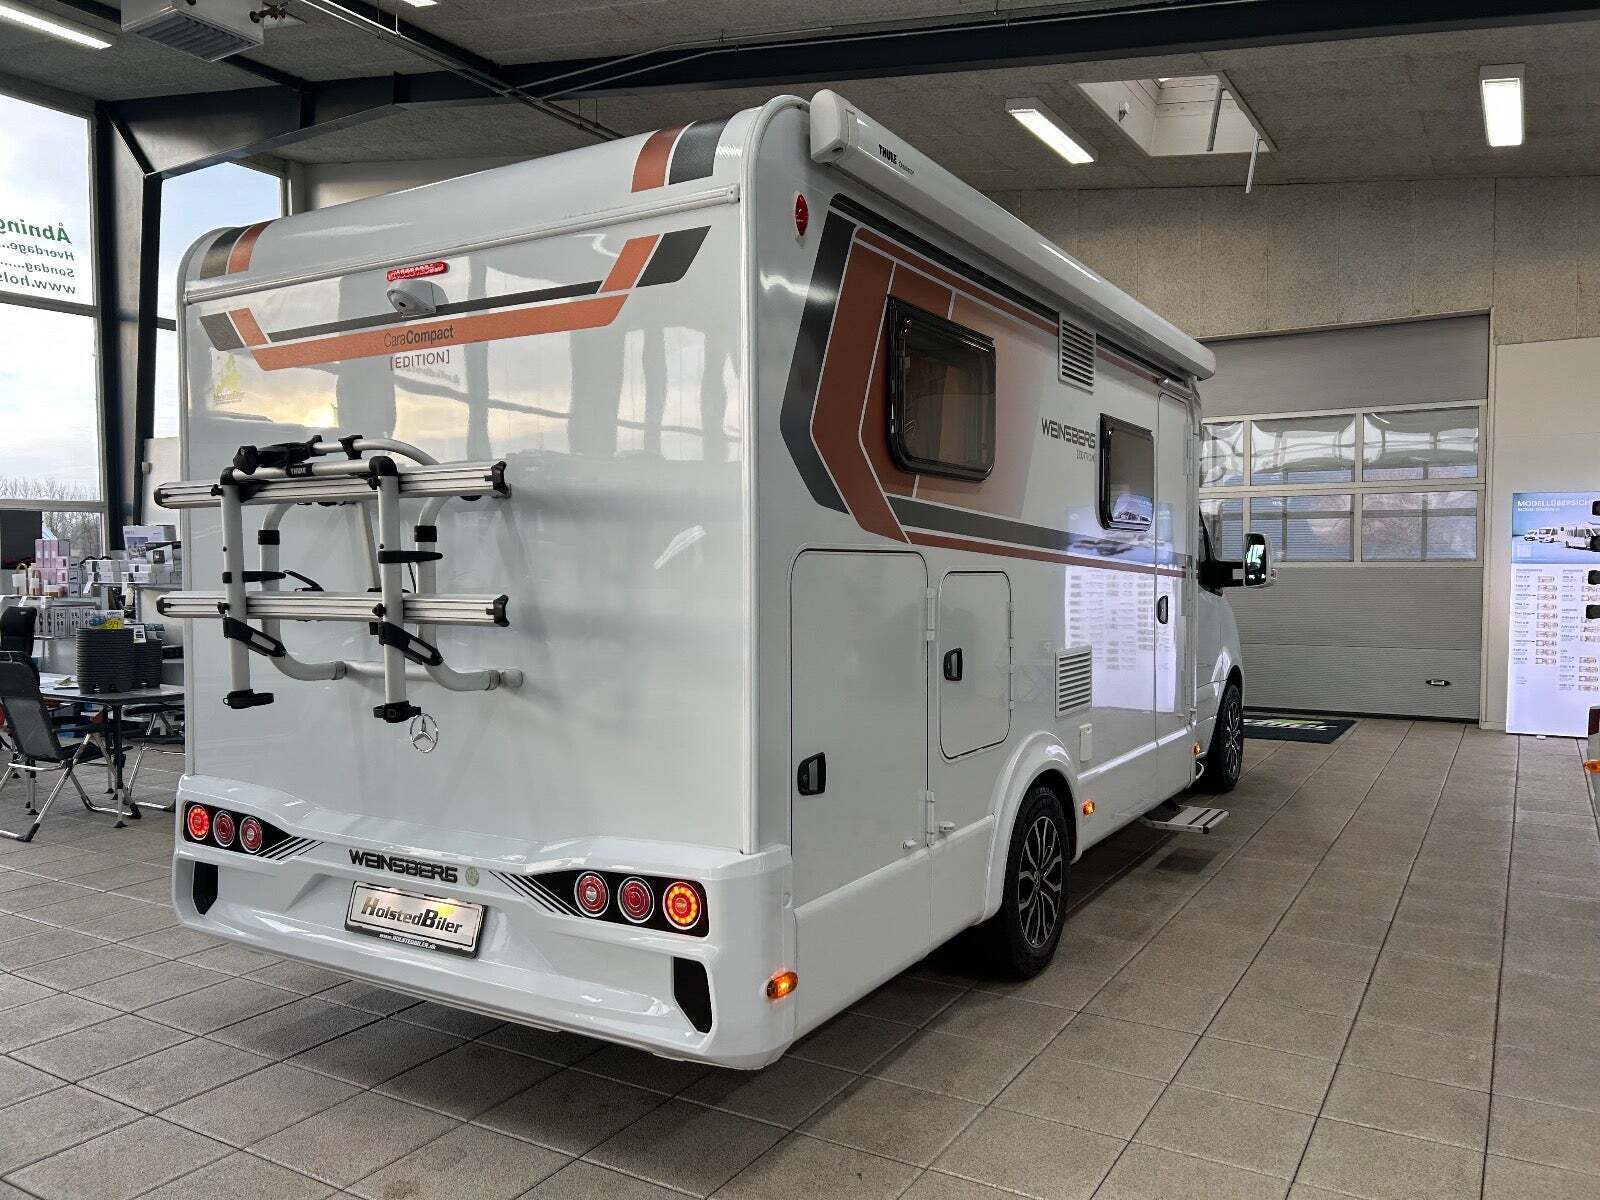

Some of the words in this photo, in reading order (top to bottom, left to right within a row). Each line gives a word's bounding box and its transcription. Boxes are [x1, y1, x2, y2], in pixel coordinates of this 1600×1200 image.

[878, 144, 897, 165] THULE
[384, 325, 454, 347] CaraCompact
[1041, 417, 1096, 449] WEINSBERG
[348, 849, 458, 883] WEINSBERG
[361, 895, 463, 934] HolstedBiler
